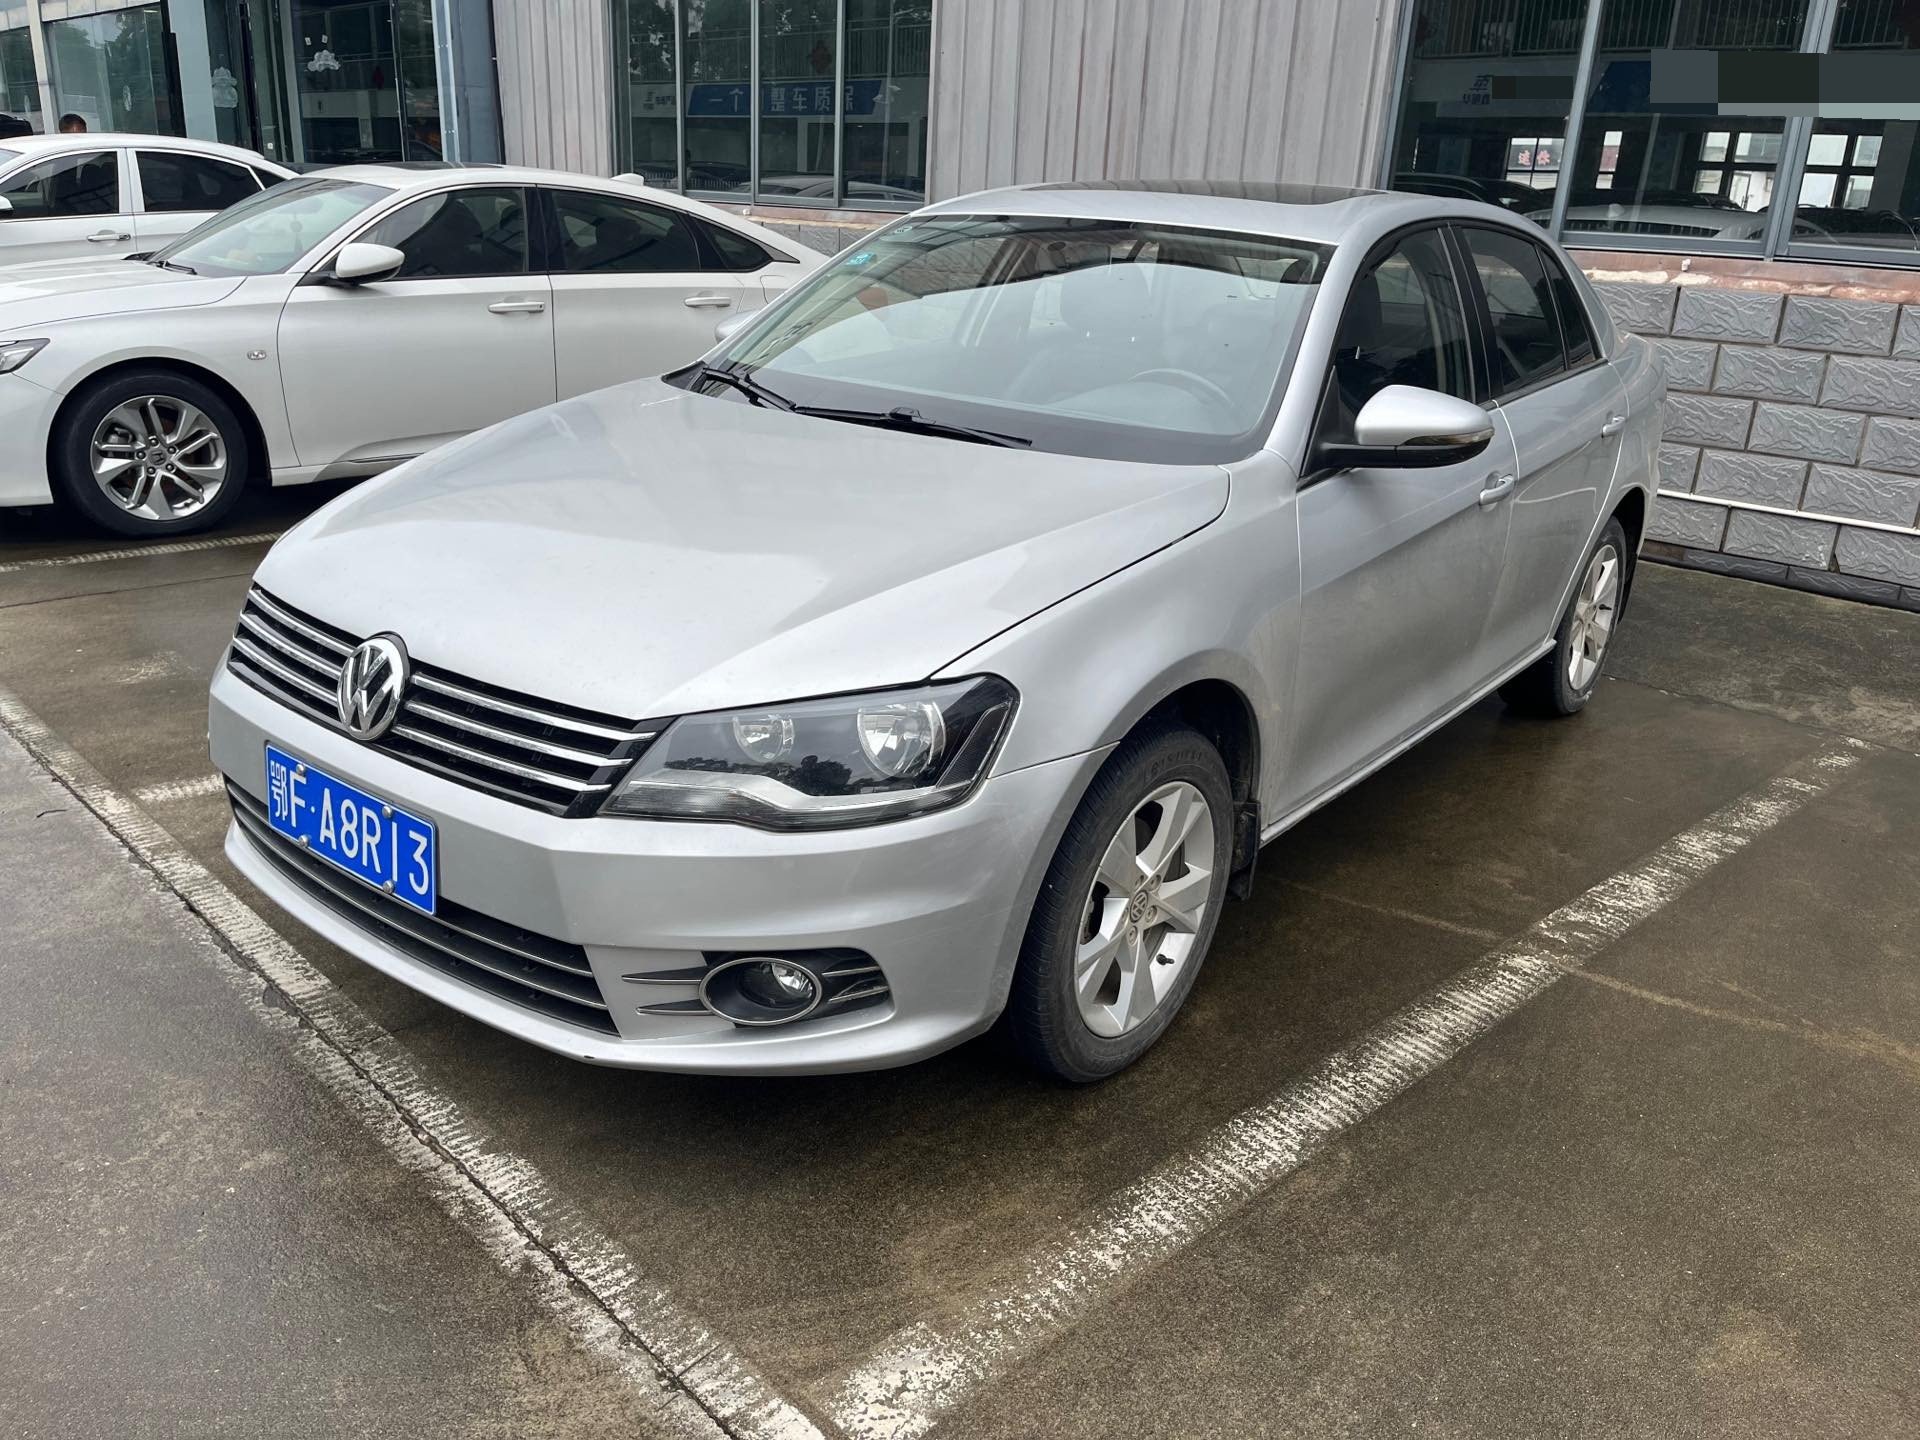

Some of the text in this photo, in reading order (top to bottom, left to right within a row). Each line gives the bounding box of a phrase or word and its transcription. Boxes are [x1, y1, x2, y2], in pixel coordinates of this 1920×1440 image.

[708, 86, 854, 112] 一个整车质保
